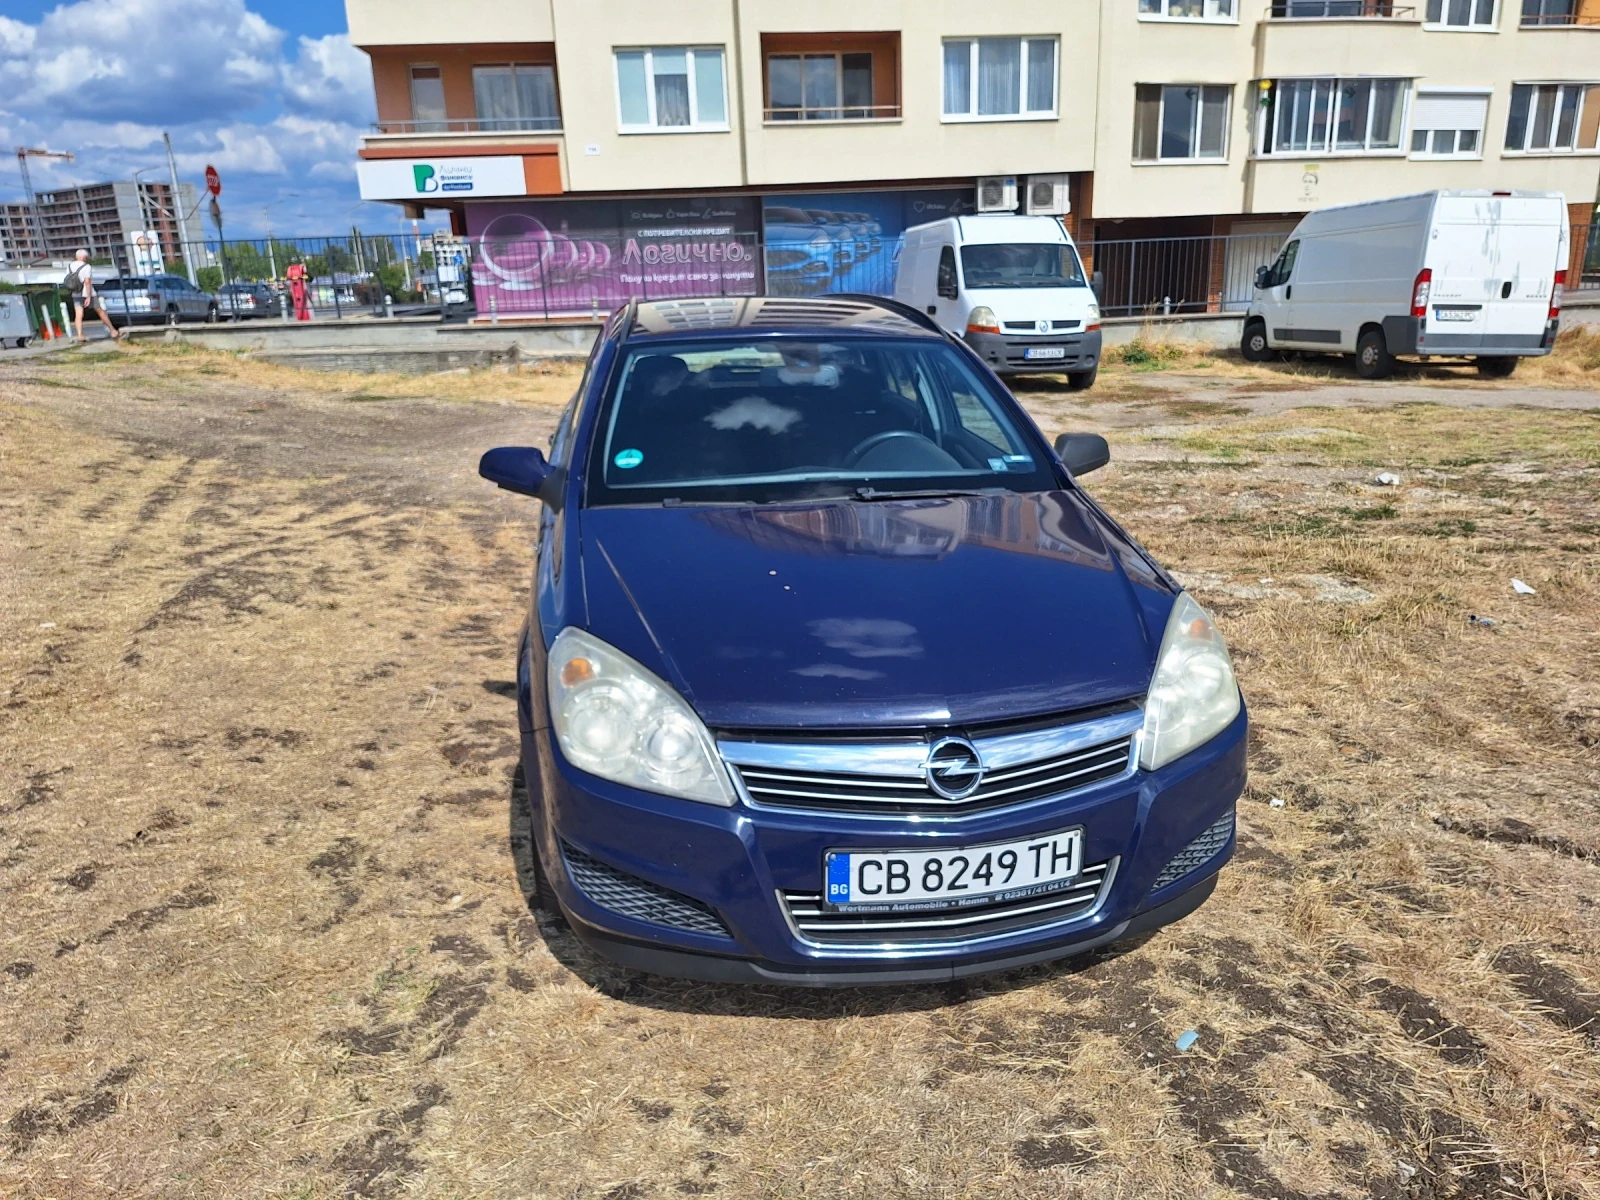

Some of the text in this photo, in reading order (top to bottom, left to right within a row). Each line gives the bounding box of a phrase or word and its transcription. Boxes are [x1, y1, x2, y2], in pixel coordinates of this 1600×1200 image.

[858, 837, 1074, 895] CB 8249 TH
[830, 884, 849, 895] BG
[838, 903, 890, 912] Wortmann
[891, 901, 948, 911] Automobile
[958, 896, 989, 906] Hamm
